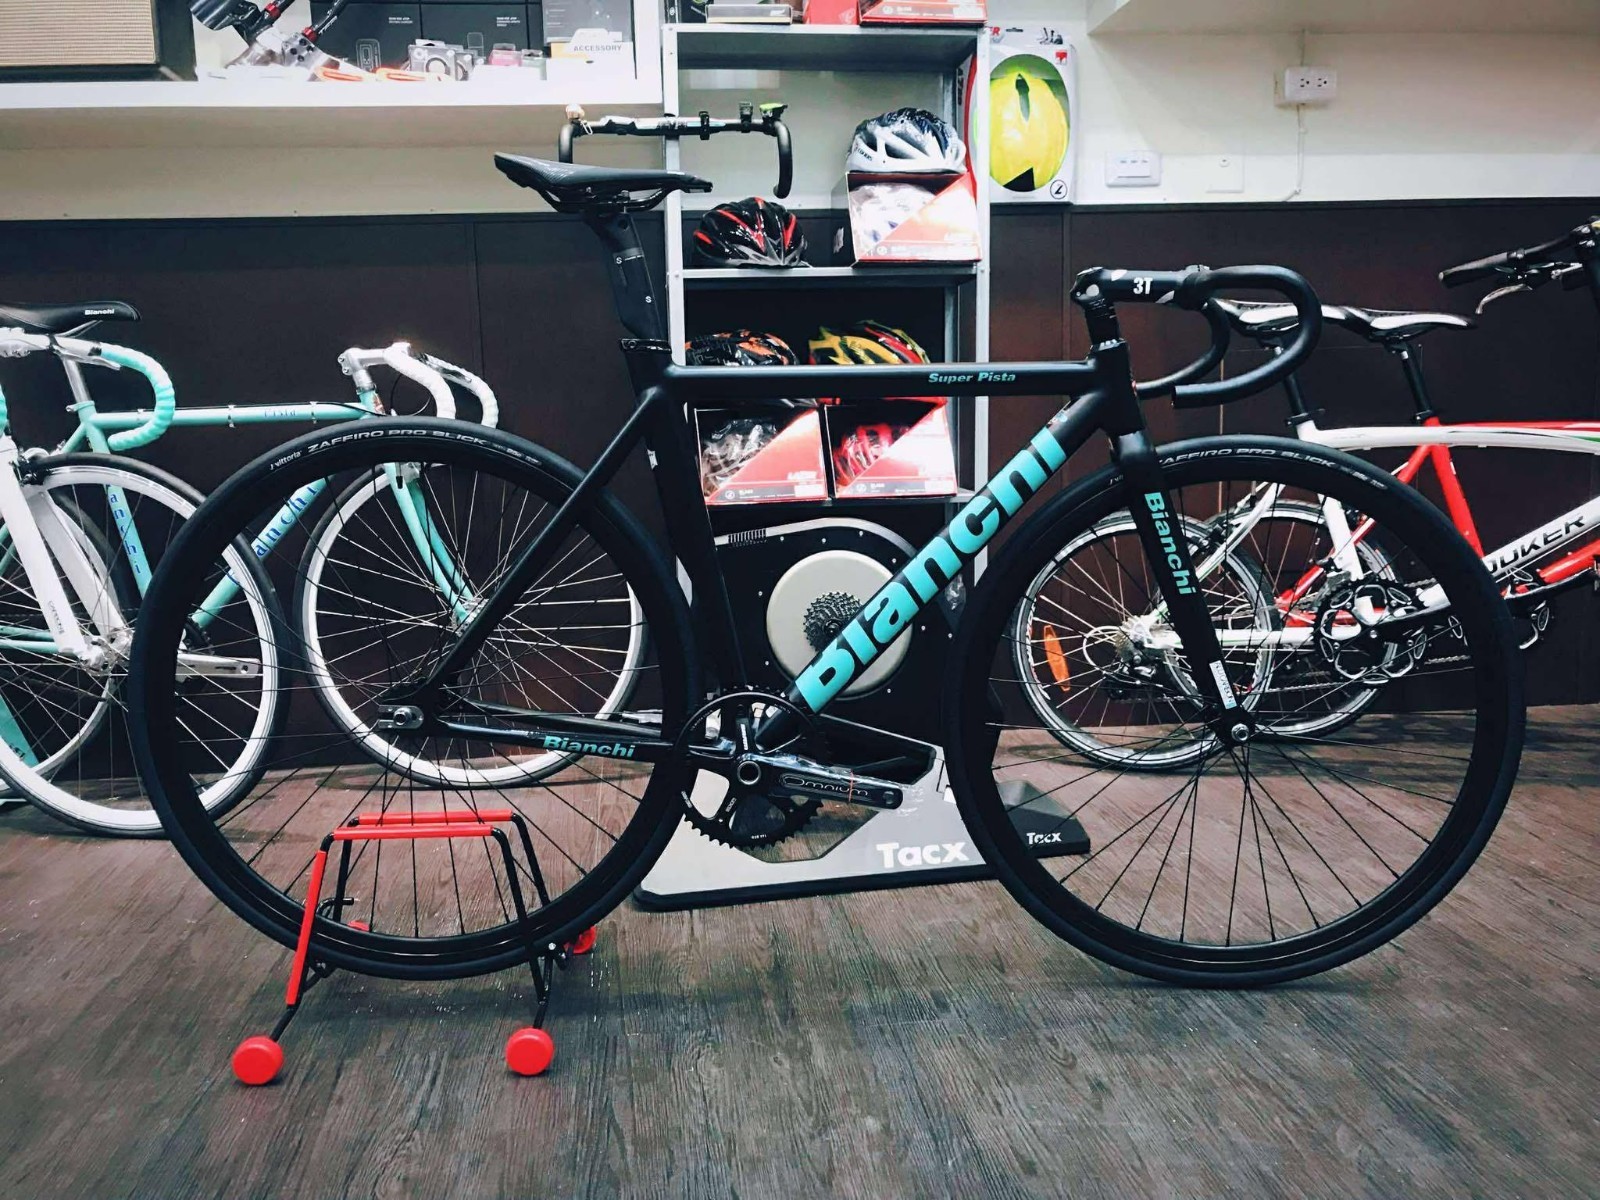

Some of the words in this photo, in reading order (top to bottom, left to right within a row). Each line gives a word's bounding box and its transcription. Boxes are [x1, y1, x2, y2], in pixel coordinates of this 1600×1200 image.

[573, 44, 622, 52] ACCESSORY
[1133, 277, 1153, 295] 3T
[928, 372, 973, 384] Super
[977, 371, 1016, 382] Pista
[308, 429, 384, 453] ZAFFIRO
[432, 430, 488, 446] SLICK
[1160, 448, 1232, 465] AFFIRO
[1236, 448, 1276, 456] PRO
[1280, 450, 1336, 468] SLICK
[1144, 492, 1196, 594] Bianchi
[543, 735, 636, 757] Bianchi
[783, 776, 868, 796] Omnium
[1026, 832, 1062, 845] Tacx
[876, 842, 969, 868] Tacx
